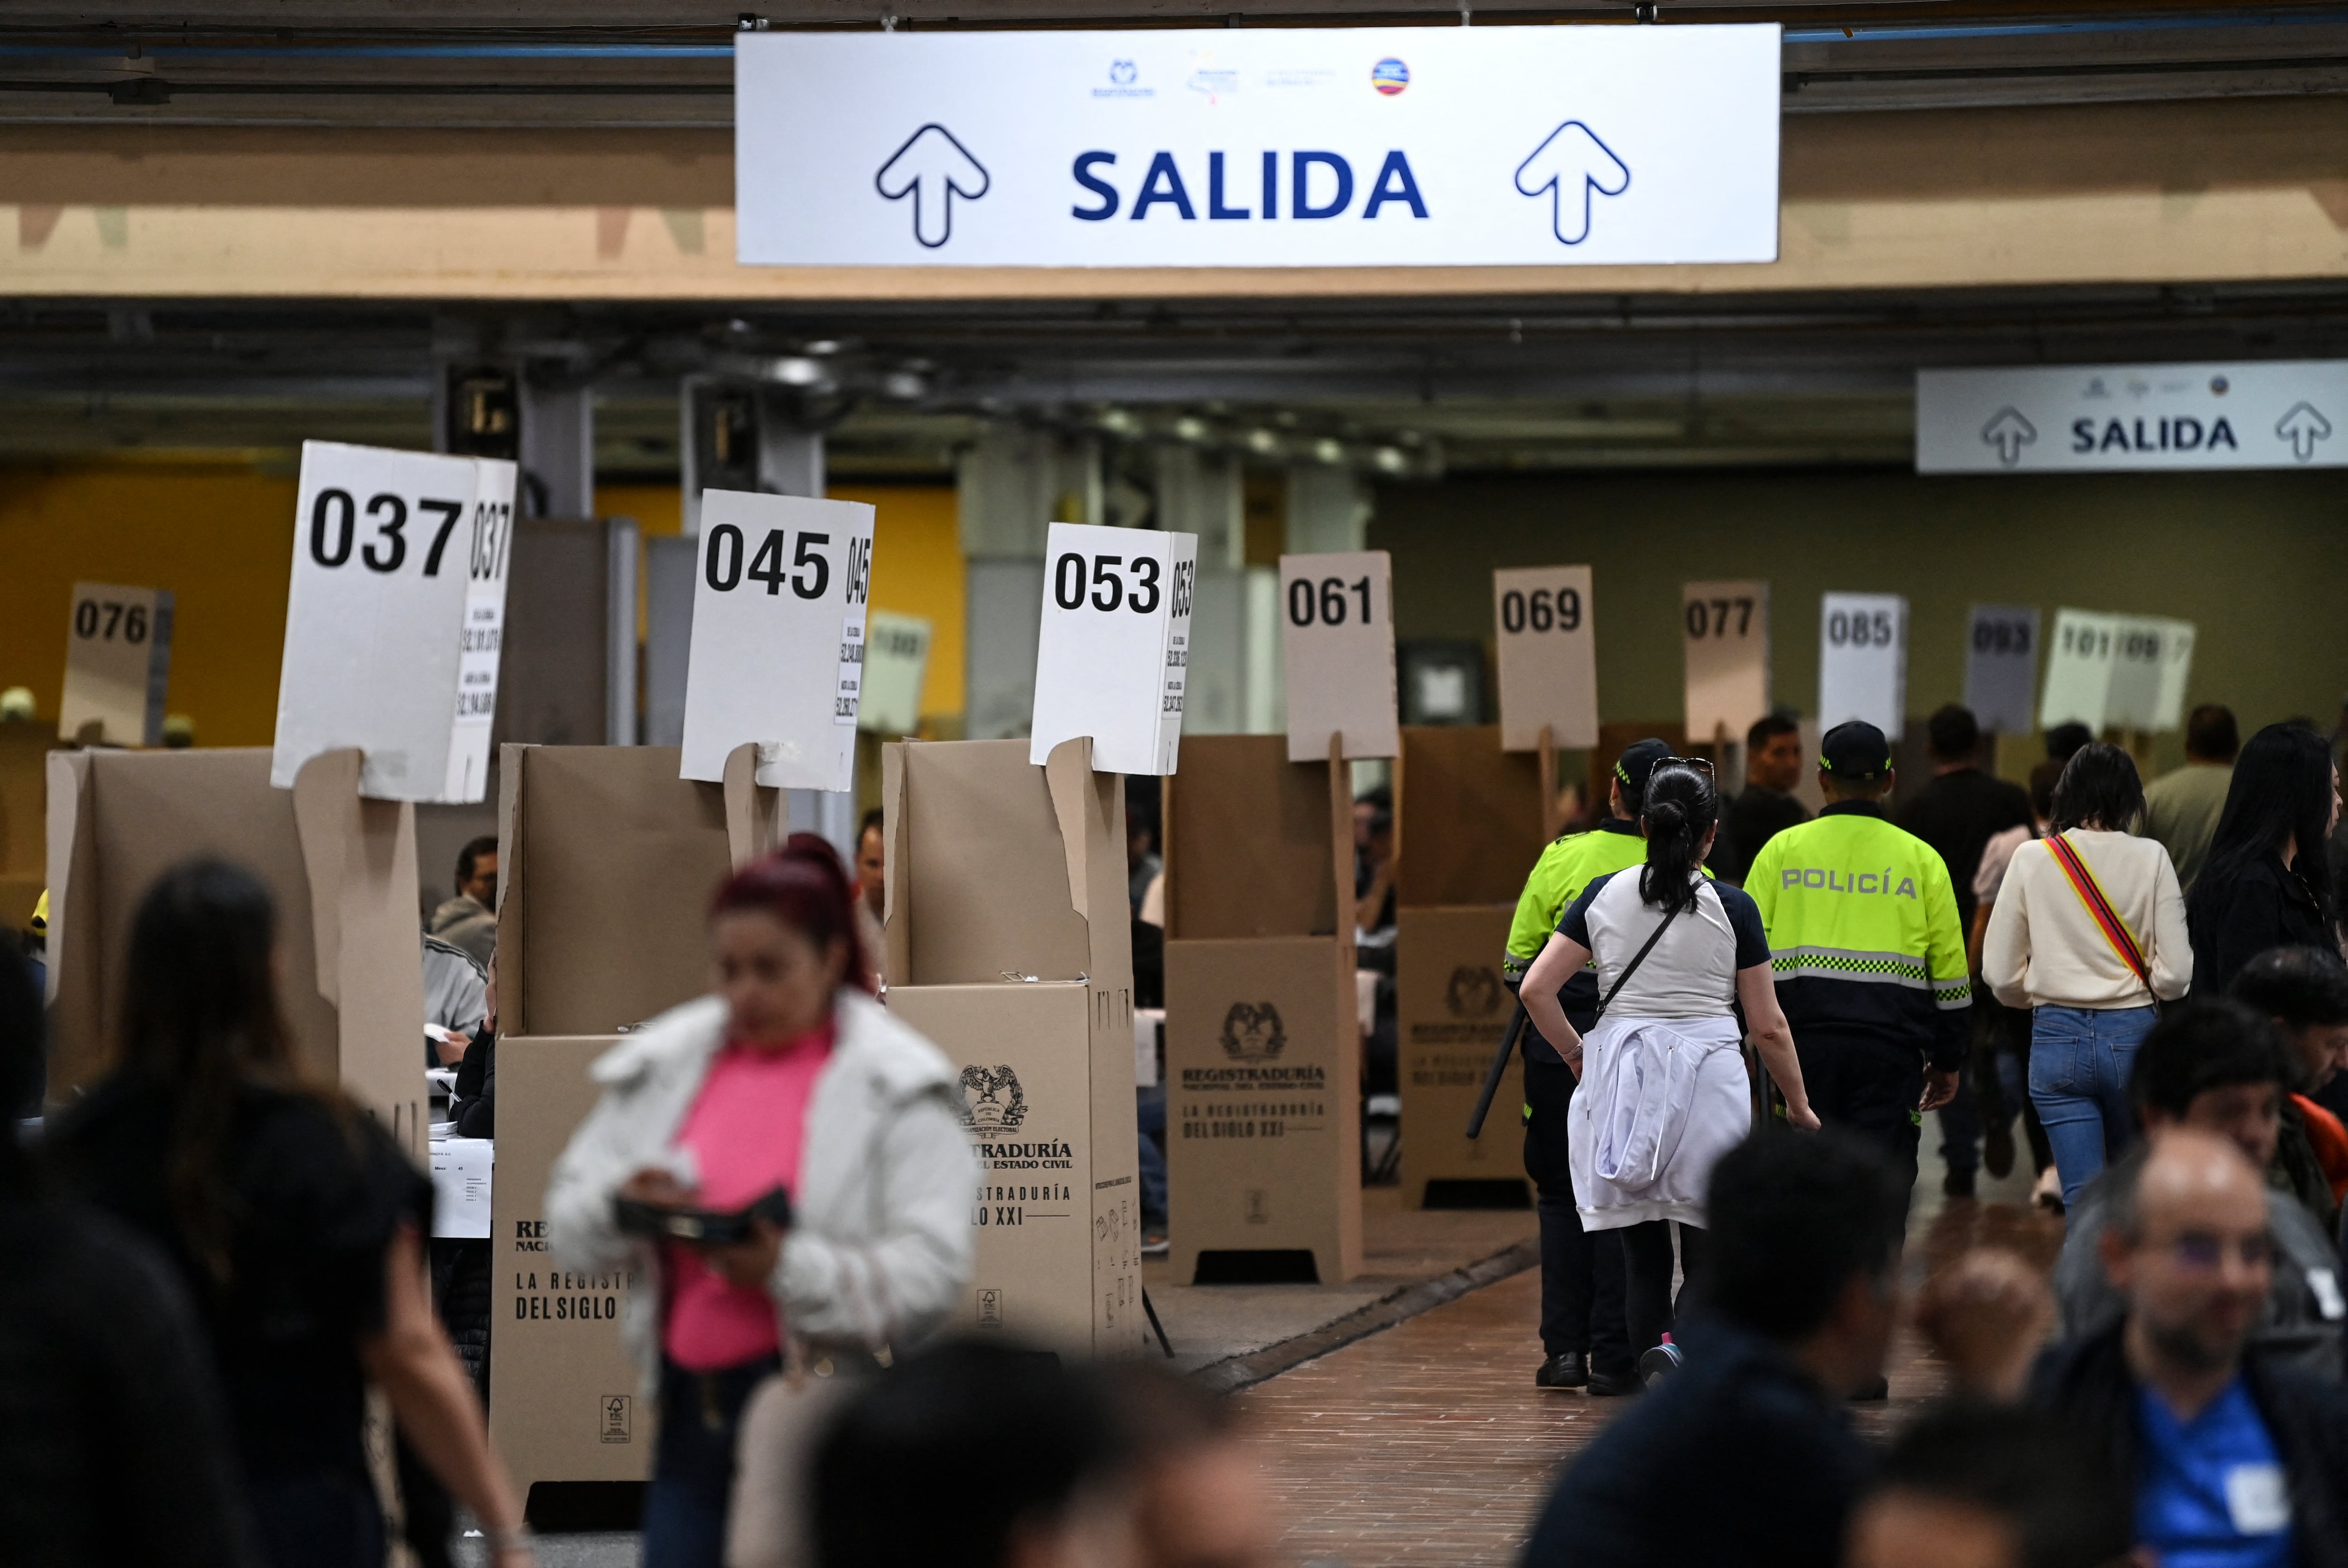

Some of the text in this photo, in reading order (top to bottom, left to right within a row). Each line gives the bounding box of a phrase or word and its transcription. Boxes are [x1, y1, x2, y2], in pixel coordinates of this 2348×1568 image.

[1072, 150, 1429, 222] SALIDA
[2071, 417, 2237, 454] SALIDA
[309, 487, 463, 578] 037
[470, 502, 510, 580] 037
[705, 523, 830, 600] 045
[846, 536, 871, 604] 045
[1055, 552, 1160, 614] 053
[1172, 559, 1194, 618] 053
[1288, 575, 1371, 627] 061
[1502, 587, 1582, 633] 069
[75, 599, 147, 644] 076
[1686, 596, 1755, 640] 077
[1828, 610, 1892, 647] 085
[1782, 867, 1917, 899] POLICÍA
[971, 1138, 1073, 1158] TRADURÍA
[977, 1160, 1073, 1169] EL ESTADO CIVIL
[976, 1183, 1070, 1201] STRADURÍA
[996, 1207, 1022, 1226] XXI
[516, 1273, 537, 1290] LA
[516, 1297, 551, 1320] DEL
[557, 1297, 616, 1320] SIGLO
